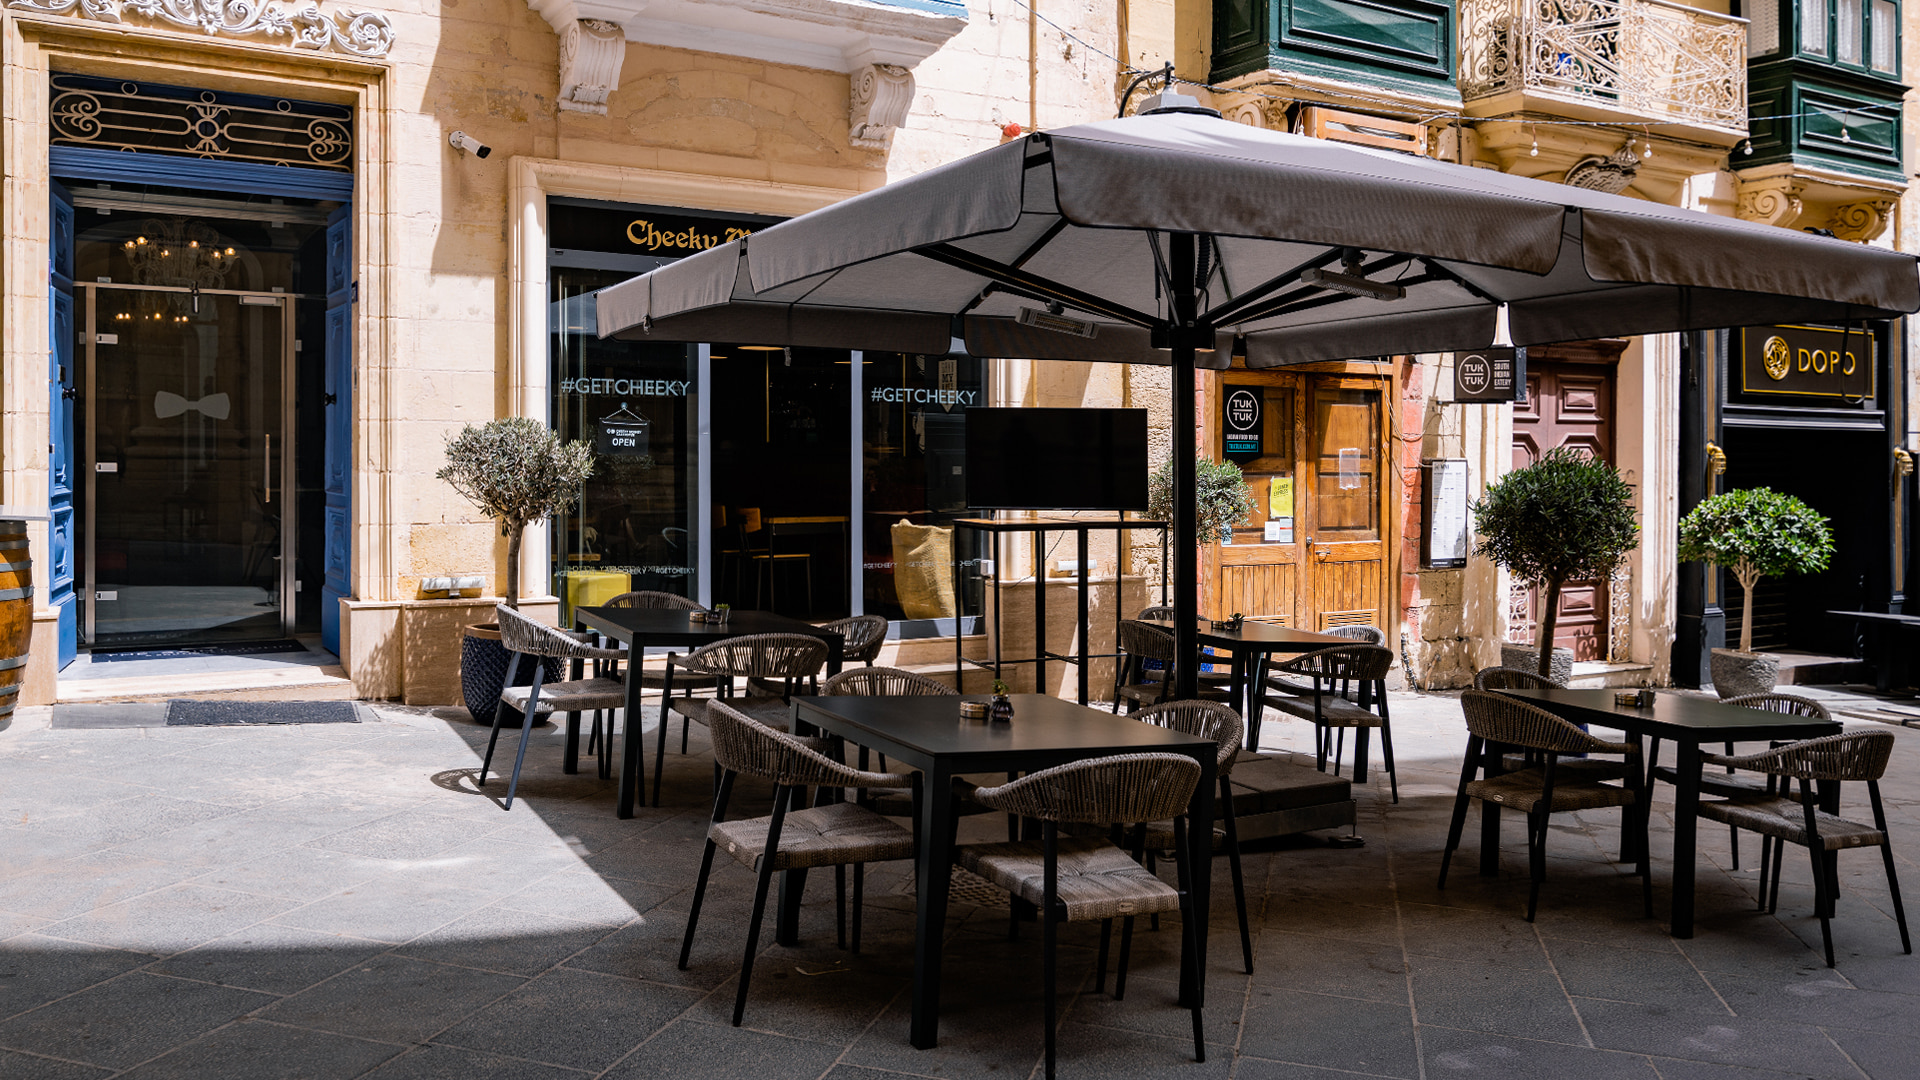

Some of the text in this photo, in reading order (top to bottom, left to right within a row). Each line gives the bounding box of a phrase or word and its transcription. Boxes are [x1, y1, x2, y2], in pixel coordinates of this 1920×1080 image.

[626, 219, 718, 251] Cheeky
[1494, 362, 1510, 370] SOUTH
[1797, 348, 1856, 376] DOPO
[1464, 363, 1484, 372] TUK
[1494, 370, 1510, 378] INDIAN
[1464, 376, 1484, 385] TUK
[561, 377, 691, 396] #GETCHEEKY
[871, 387, 977, 405] #GETCHEEKY
[1233, 399, 1252, 408] TUK
[1233, 412, 1252, 421] TUK
[612, 438, 636, 447] OPEN
